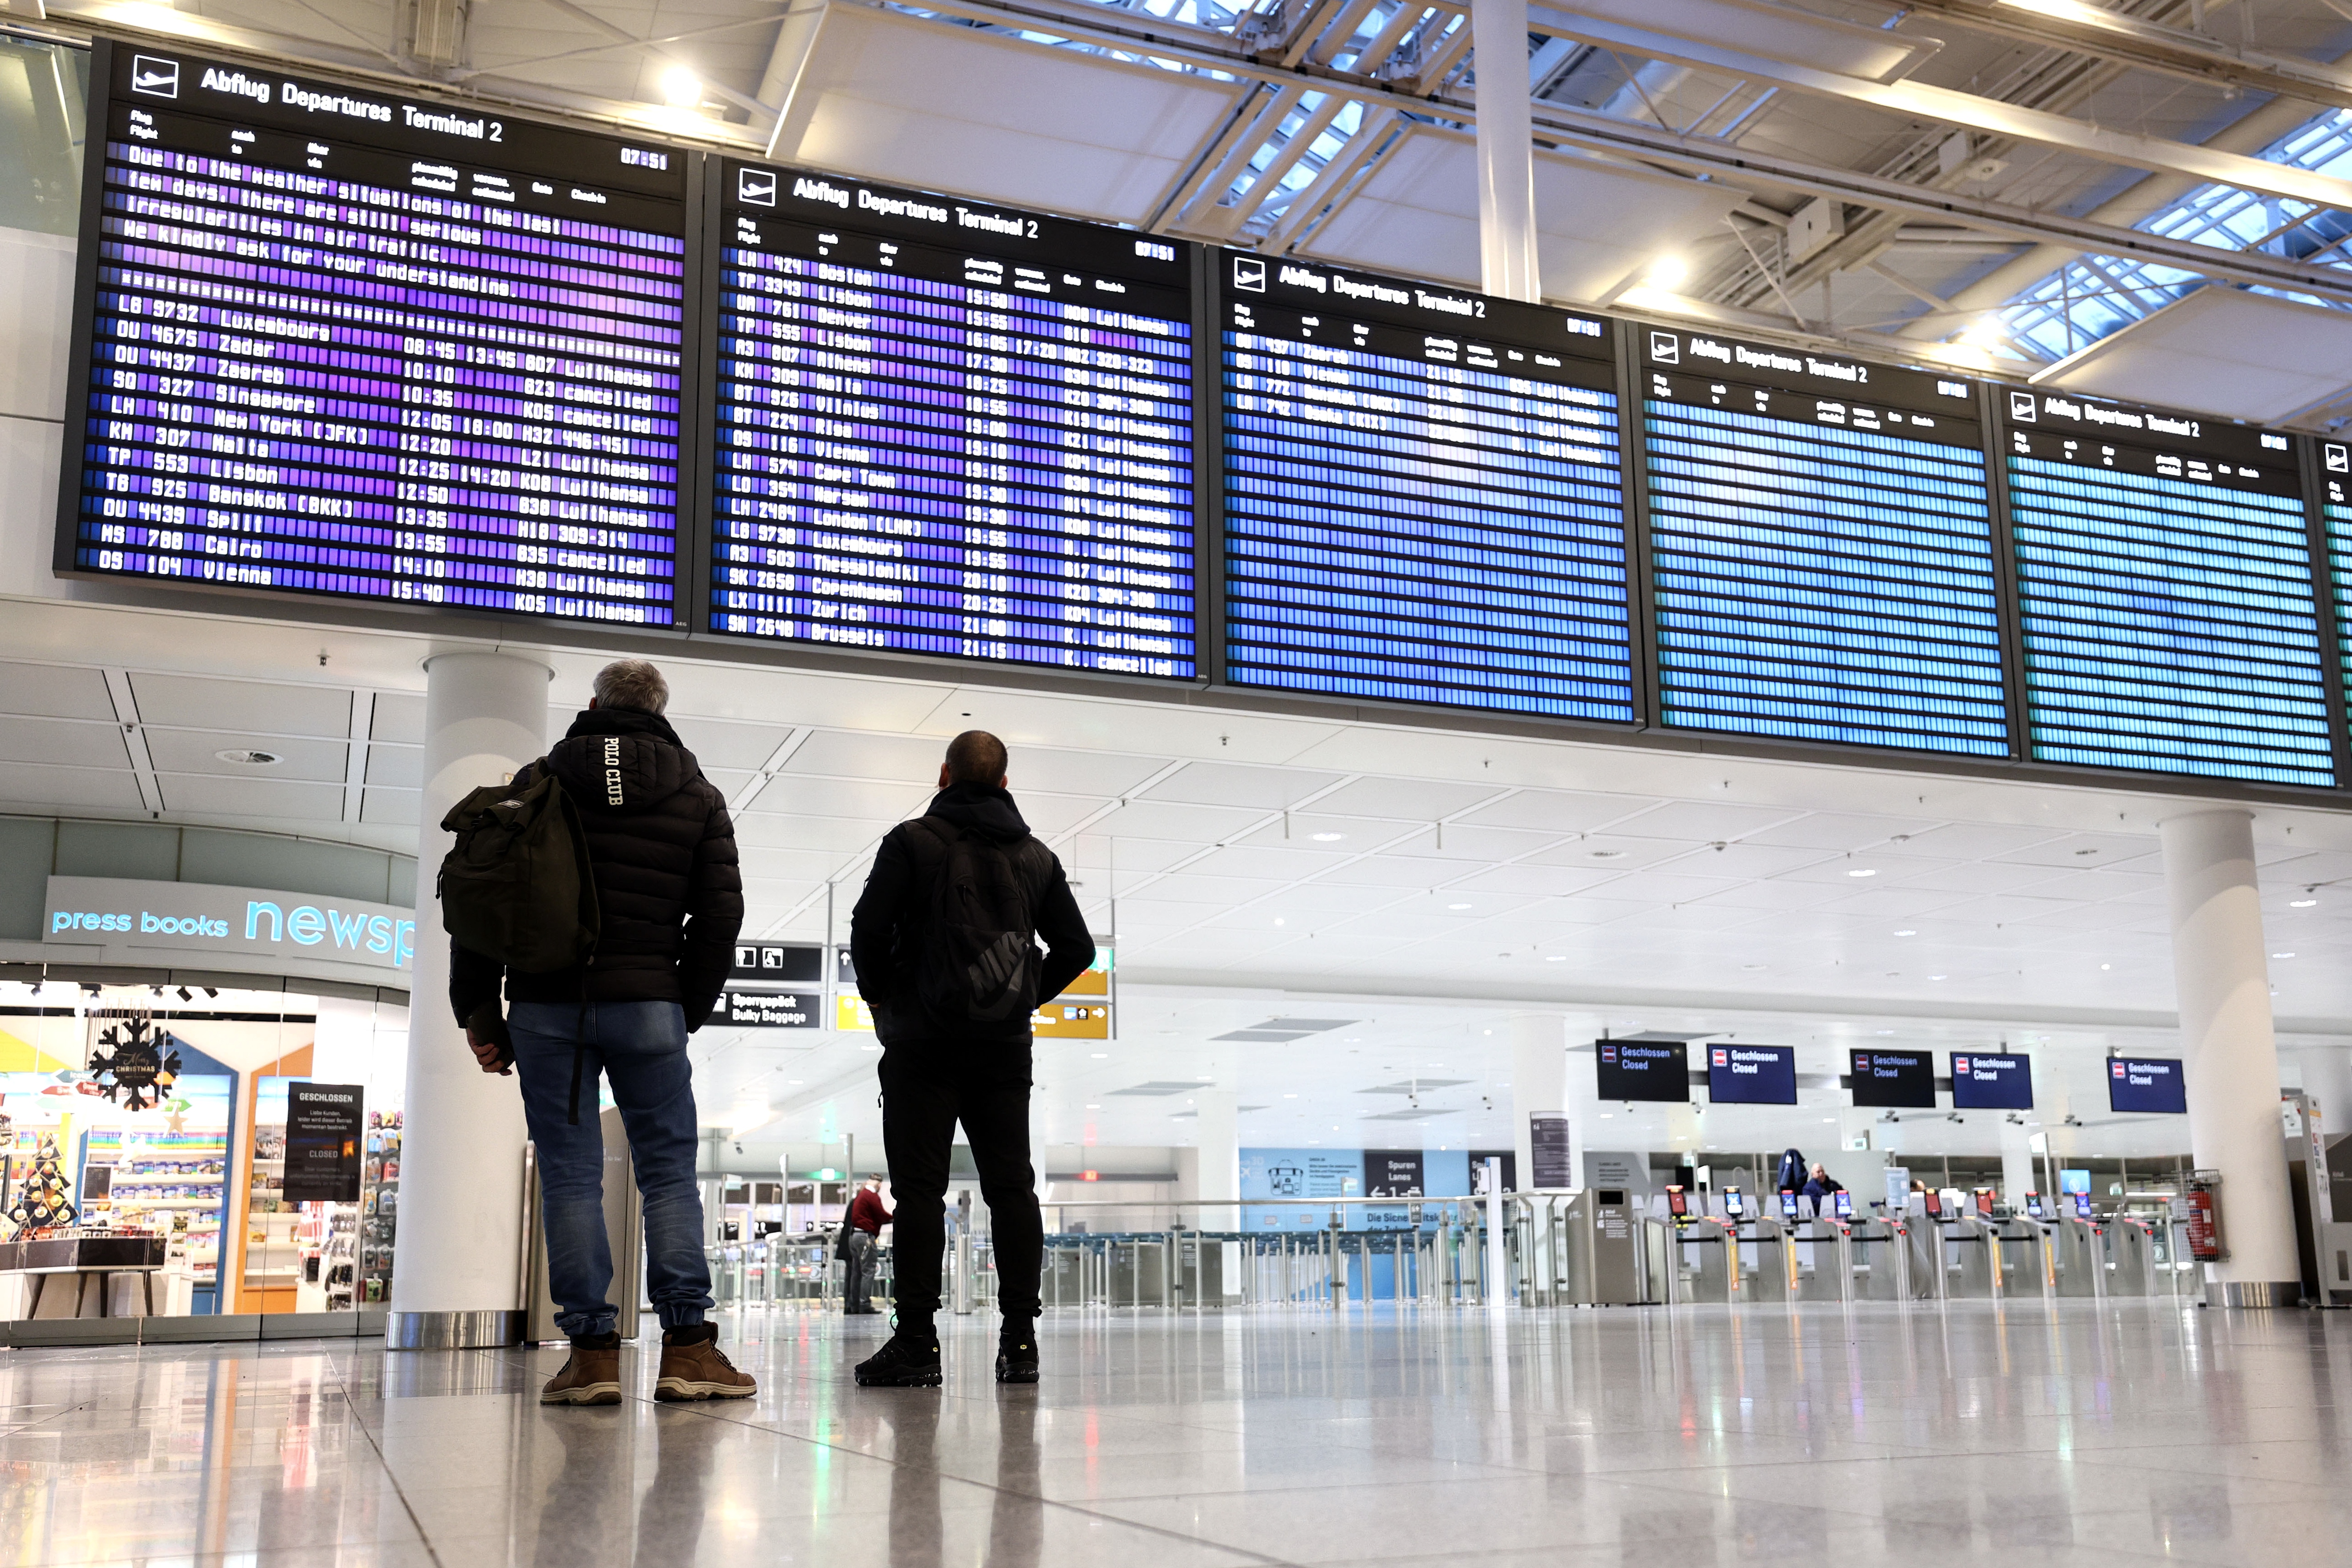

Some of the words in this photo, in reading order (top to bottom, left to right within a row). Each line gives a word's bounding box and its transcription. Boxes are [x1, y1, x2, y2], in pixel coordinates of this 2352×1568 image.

[201, 68, 269, 103] Abflug
[283, 83, 391, 121] Departures
[402, 105, 483, 139] Terminal
[490, 122, 502, 142] 2
[621, 148, 666, 170] 07:51
[129, 146, 163, 167] Due
[177, 154, 197, 173] to
[211, 160, 241, 180] the
[252, 171, 327, 194] weather
[339, 185, 442, 215] situations
[452, 204, 470, 219] of
[484, 208, 512, 227] the
[523, 214, 559, 234] last
[130, 171, 161, 191] few
[242, 190, 294, 214] there
[305, 204, 337, 221] are
[348, 210, 397, 231] still
[411, 222, 481, 245] serious
[794, 177, 849, 208] Abflug
[859, 189, 947, 222] Departures
[956, 207, 1022, 236] Terminal
[1027, 221, 1038, 238] 2
[129, 196, 282, 236] irregularities
[294, 223, 314, 242] in
[324, 230, 357, 248] air
[369, 235, 446, 263] traffic.
[124, 220, 147, 239] We
[158, 225, 225, 251] kindly
[237, 242, 269, 258] ask
[283, 246, 313, 265] for
[324, 255, 366, 273] your
[377, 264, 516, 297] understanding.
[1280, 266, 1326, 293] Abflug
[1334, 275, 1409, 304] Departures
[1415, 290, 1472, 316] Terminal
[1476, 302, 1485, 318] 2
[154, 300, 198, 323] 9732
[221, 310, 329, 341] Luxembourg
[404, 337, 455, 359] 08:45
[467, 346, 516, 368] 13:45
[565, 360, 652, 387] Lufthansa
[773, 300, 799, 318] 761
[818, 308, 871, 329] Denver
[967, 332, 1007, 351] 16:05
[1017, 339, 1057, 359] 17:20
[1690, 338, 1730, 363] Abflug
[1736, 346, 1802, 372] Departures
[1806, 358, 1856, 381] Terminal
[1858, 367, 1867, 382] 2
[150, 350, 195, 371] 4437
[218, 359, 284, 384] Zagreb
[403, 386, 453, 407] 10:35
[563, 410, 650, 434] cancelled
[159, 377, 194, 397] 327
[216, 385, 315, 413] Singapore
[402, 410, 452, 431] 12:05
[464, 417, 512, 439] 18:00
[522, 425, 553, 445] H32
[563, 431, 629, 454] 446-451
[2045, 397, 2080, 421] Abflug
[2085, 404, 2142, 428] Departures
[2145, 414, 2190, 436] Terminal
[2191, 422, 2199, 437] 2
[112, 396, 134, 415] LH
[158, 402, 192, 422] 410
[214, 409, 248, 429] New
[260, 415, 302, 437] York
[401, 434, 451, 456] 12:20
[521, 449, 550, 468] L21
[561, 454, 649, 480] Lufthansa
[109, 422, 133, 440] KM
[156, 427, 190, 447] 307
[213, 434, 268, 457] Malta
[400, 458, 449, 480] 12:25
[461, 466, 511, 487] 14:20
[561, 478, 648, 504] Lufthansa
[733, 452, 751, 470] LH
[769, 457, 797, 476] 574
[815, 463, 851, 483] Cape
[860, 469, 895, 488] Town
[966, 484, 1007, 503] 19:30
[1097, 501, 1170, 524] Lufthansa
[148, 556, 181, 576] 104
[204, 561, 271, 585] Vienna
[393, 581, 443, 602] 15:40
[556, 598, 644, 622] Lufthansa
[729, 591, 748, 609] LX
[758, 595, 792, 614] 1111
[812, 600, 867, 621] Zurich
[963, 617, 1006, 636] 21:00
[605, 737, 619, 766] POLO
[605, 769, 623, 805] CLUB
[52, 910, 131, 933] press
[141, 911, 228, 937] books
[968, 931, 1030, 996] NIKE
[732, 993, 796, 1009] Sperrgepäck
[732, 1009, 761, 1022] Bulky
[762, 1010, 806, 1024] Baggage
[1621, 1046, 1670, 1058] Geschlossen
[1622, 1059, 1648, 1071] Closed
[1732, 1050, 1778, 1062] Geschlossen
[1732, 1063, 1757, 1074] Closed
[1873, 1055, 1917, 1066] Geschlossen
[1973, 1057, 2015, 1069] Geschlossen
[2129, 1063, 2169, 1074] Geschlossen
[1874, 1066, 1897, 1077] Closed
[1974, 1070, 1997, 1081] Closed
[2129, 1074, 2152, 1085] Closed
[299, 1092, 353, 1103] GESCHLOSSEN
[1388, 1161, 1415, 1171] Spuren
[1388, 1172, 1410, 1181] Lanes
[1367, 1213, 1381, 1222] Die
